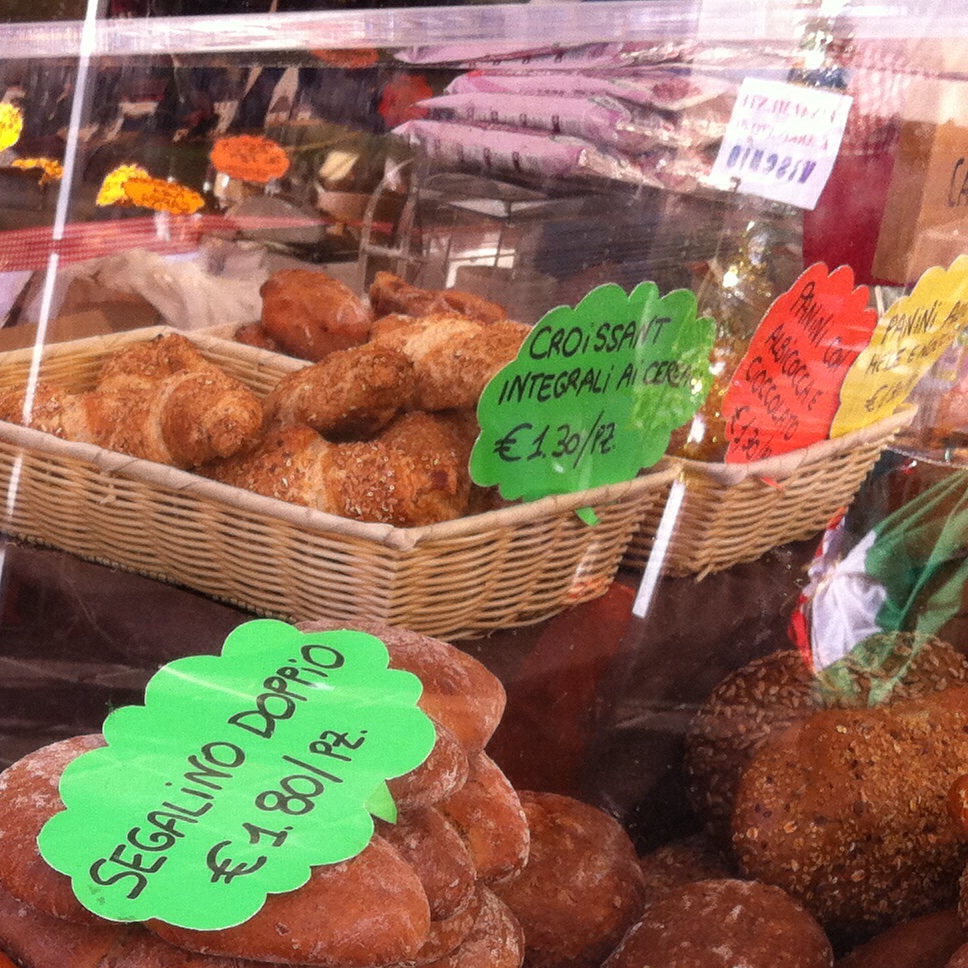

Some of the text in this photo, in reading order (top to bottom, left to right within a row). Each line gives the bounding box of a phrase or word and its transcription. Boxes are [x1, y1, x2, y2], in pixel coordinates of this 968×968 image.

[790, 281, 834, 348] PANINI
[881, 299, 943, 345] PANINI
[530, 316, 672, 360] CROISSANT
[498, 365, 614, 405] INTEGRALI
[616, 359, 644, 391] AI
[89, 644, 345, 899] SEGALINO DOPPIO
